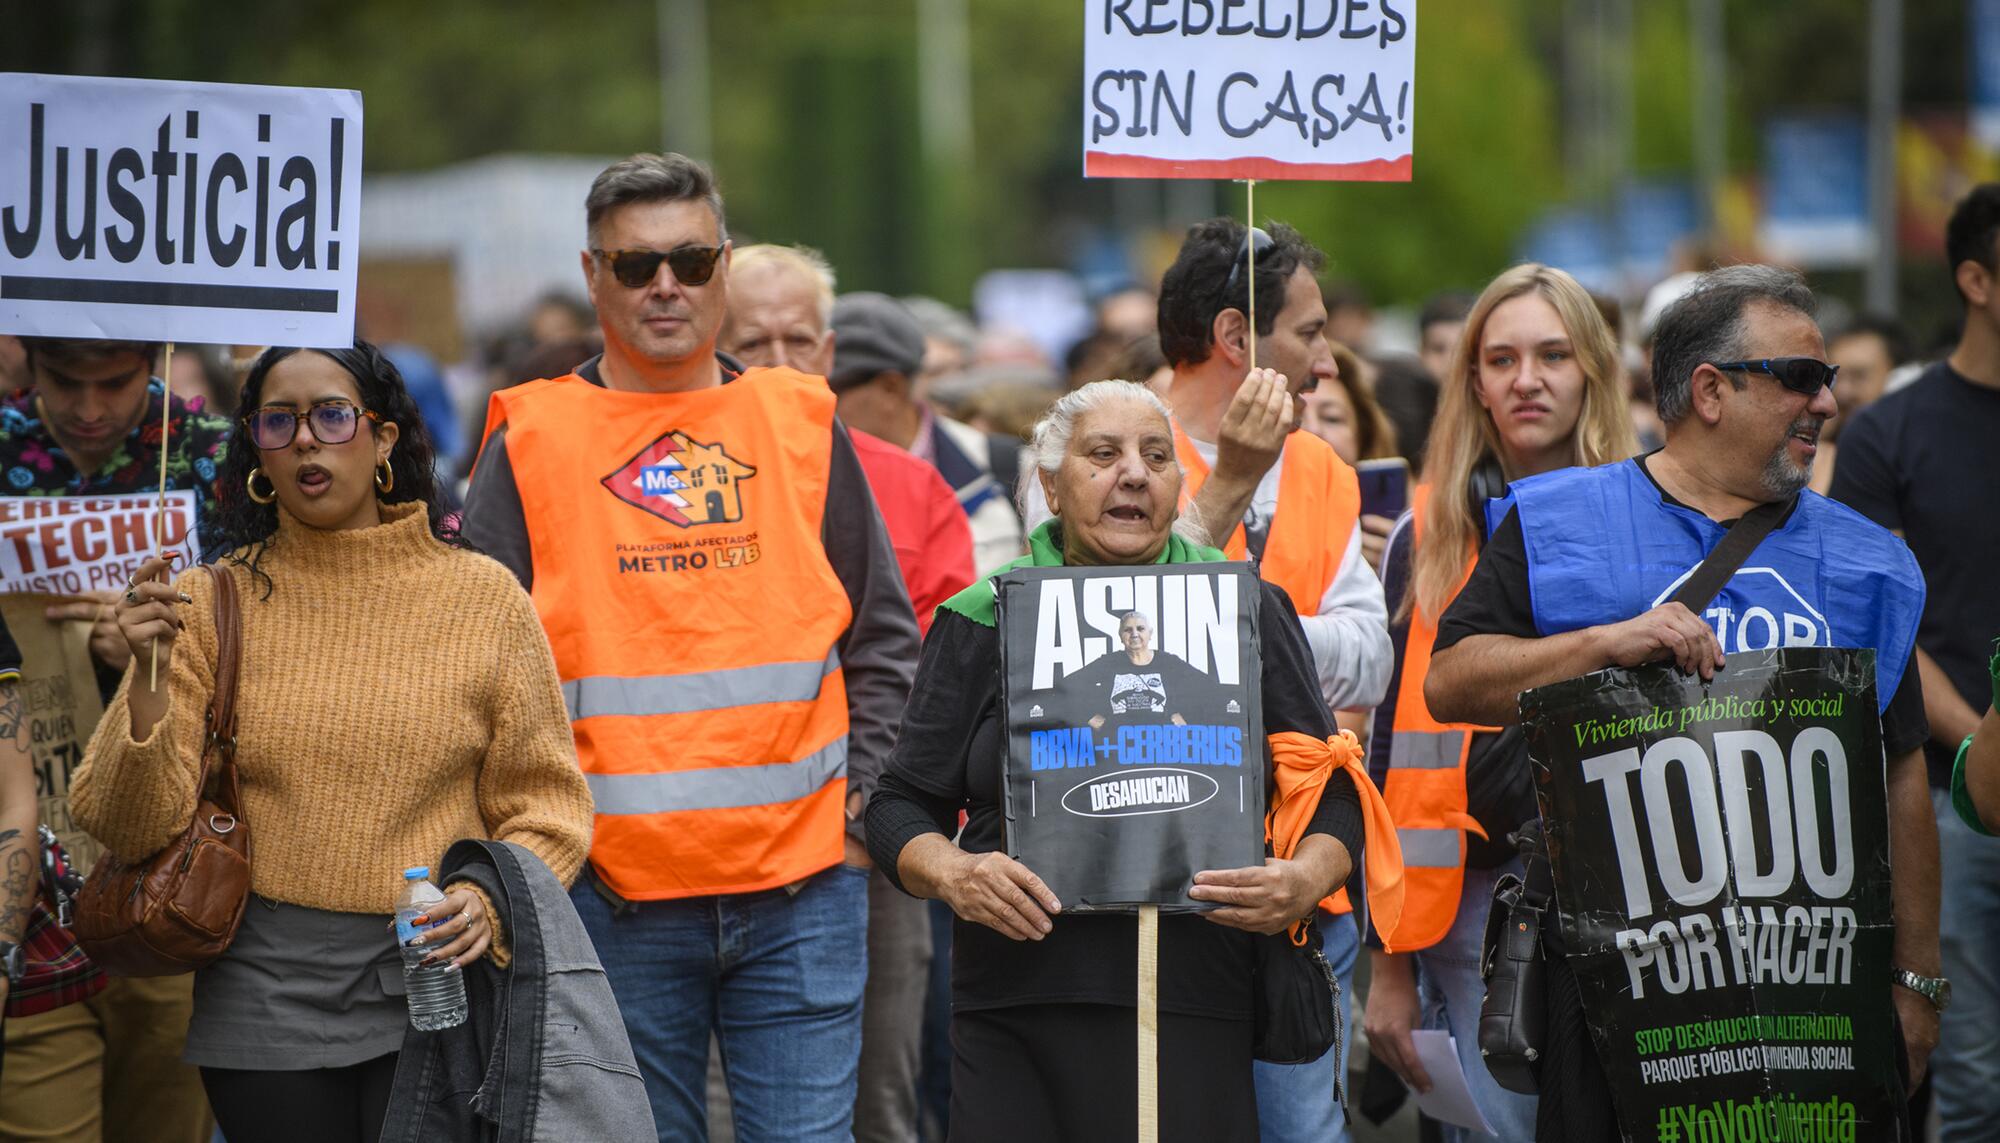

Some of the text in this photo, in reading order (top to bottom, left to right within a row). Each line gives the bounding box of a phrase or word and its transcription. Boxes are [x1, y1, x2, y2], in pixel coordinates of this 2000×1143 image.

[1092, 69, 1408, 148] SIN CASA!
[2, 103, 345, 271] Justicia!
[4, 509, 186, 574] TECHO
[616, 531, 758, 552] PLATAFORMA AFECTADOS
[619, 543, 761, 573] METRO L7B
[1031, 574, 1240, 690] ASUN
[1701, 606, 1818, 655] TOP
[1573, 692, 1845, 748] Vivienda pública y social
[1090, 775, 1190, 812] DESAHUCIAN
[1581, 726, 1855, 920] TODO
[1616, 905, 1858, 999] POR HACER
[1635, 1027, 1673, 1056] STOP
[1776, 1015, 1853, 1041] ALTERNATIVA
[1640, 1054, 1700, 1085] PARQUE
[1700, 1046, 1762, 1078] PÚBLICO
[1811, 1046, 1855, 1070] SOCIAL
